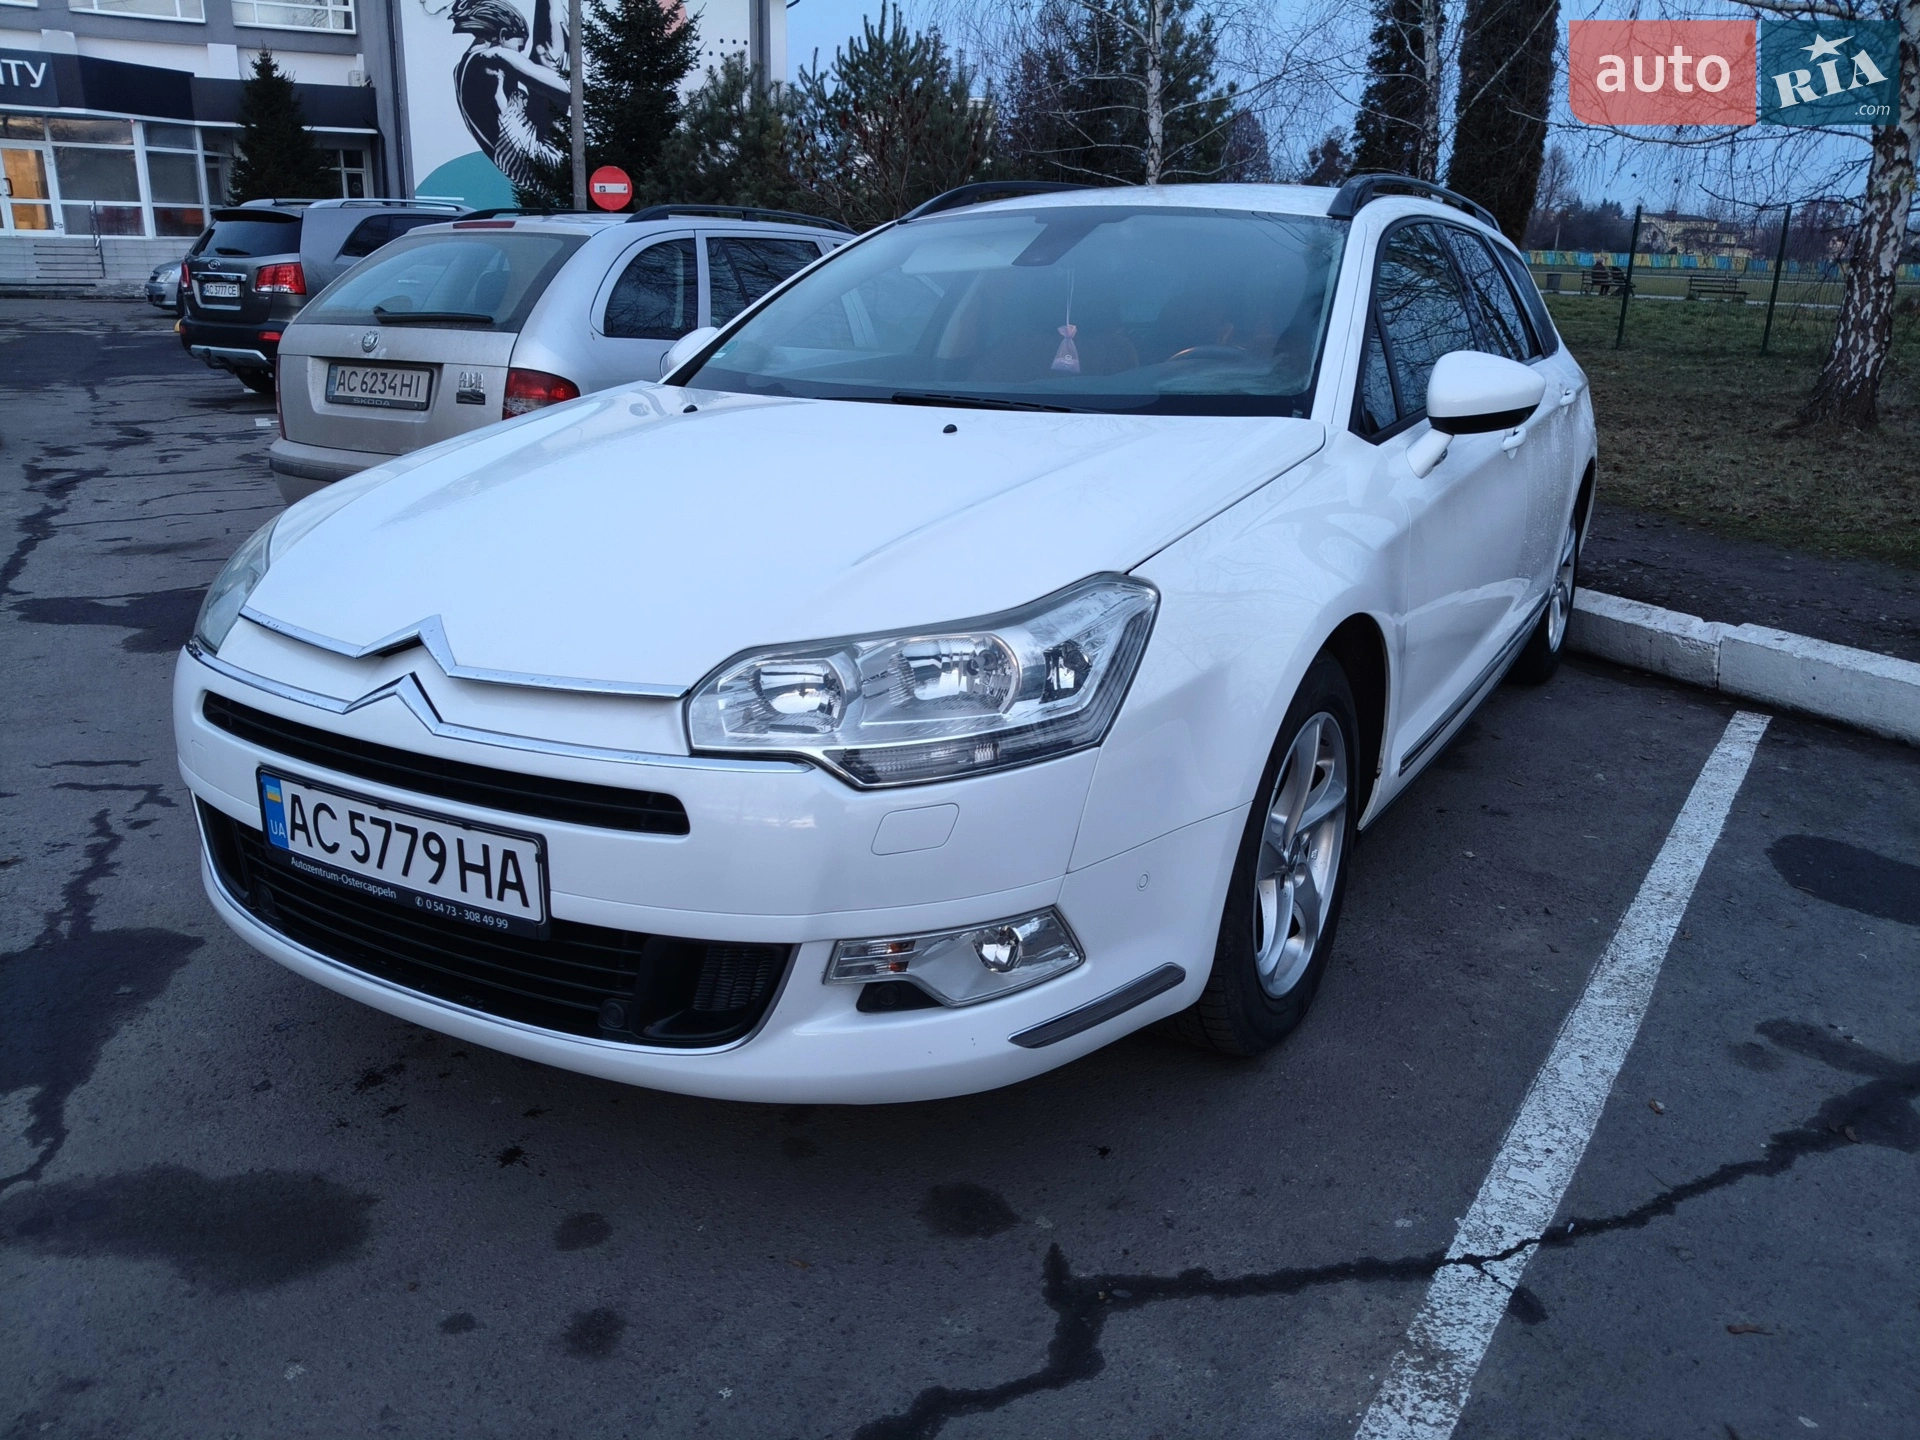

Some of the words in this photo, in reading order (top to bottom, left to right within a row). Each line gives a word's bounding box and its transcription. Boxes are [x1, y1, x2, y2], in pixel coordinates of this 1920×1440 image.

[205, 284, 214, 295] AC
[228, 286, 237, 296] CE
[336, 370, 358, 392] AC
[360, 369, 398, 396] 6234
[399, 373, 421, 398] HI
[353, 397, 391, 406] SKODA
[270, 819, 286, 839] UA
[290, 793, 340, 854] AC
[348, 809, 447, 885] 5779
[456, 837, 530, 908] HA
[290, 856, 397, 899] Autozentrum-Ostercappeln
[425, 899, 432, 909] 0
[433, 901, 444, 913] 54
[446, 904, 457, 917] 73
[463, 909, 481, 923] 308
[482, 914, 494, 926] 49
[496, 917, 509, 929] 99
